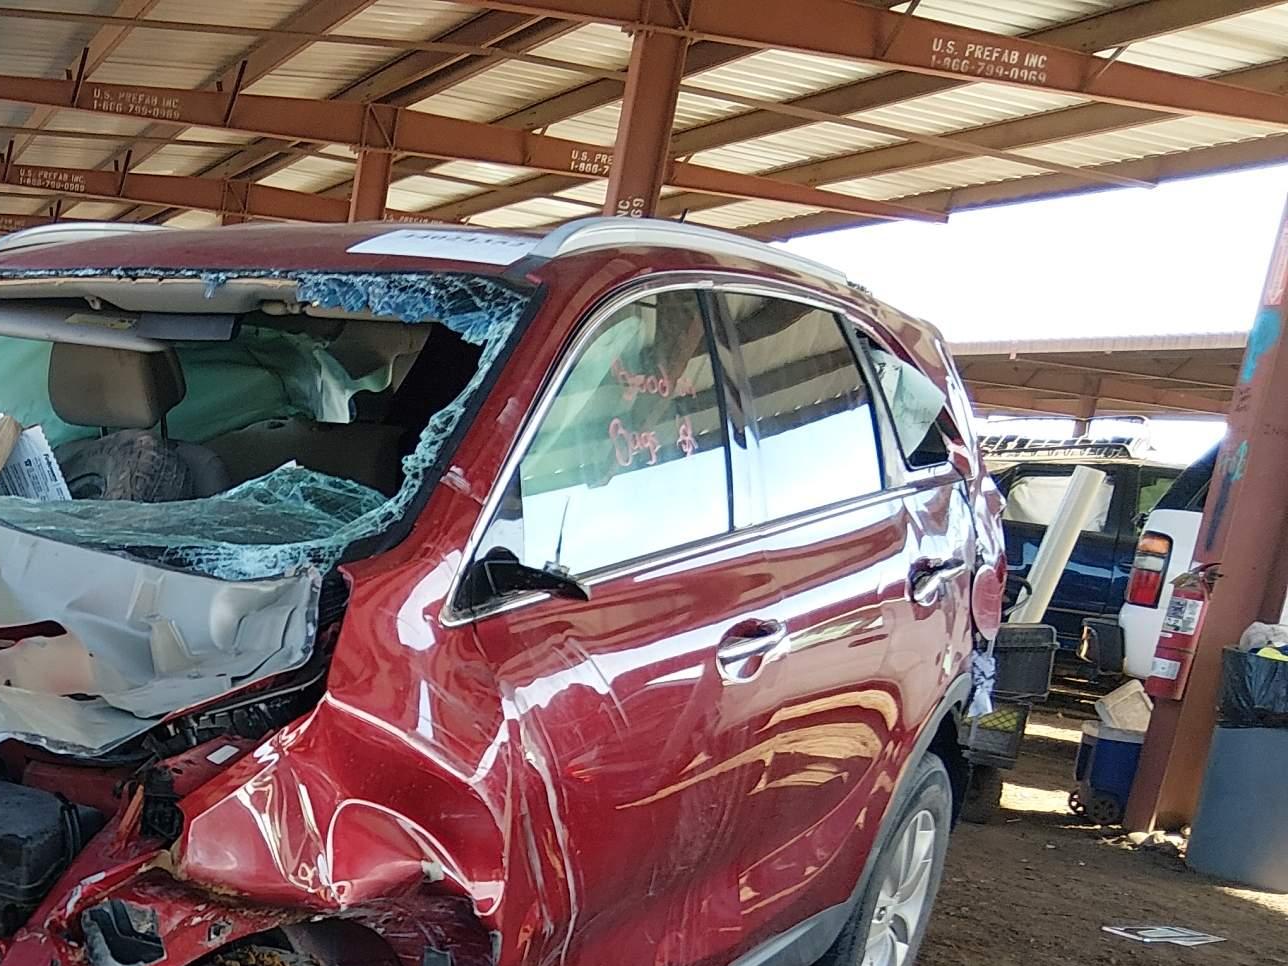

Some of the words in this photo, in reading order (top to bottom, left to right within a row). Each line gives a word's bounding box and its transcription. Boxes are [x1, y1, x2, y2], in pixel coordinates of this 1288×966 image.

[932, 38, 958, 55] U.S.
[965, 43, 1020, 64] PREFAB
[93, 87, 113, 101] U.S.
[119, 91, 158, 106] PREFAB
[571, 150, 591, 163] U.S.
